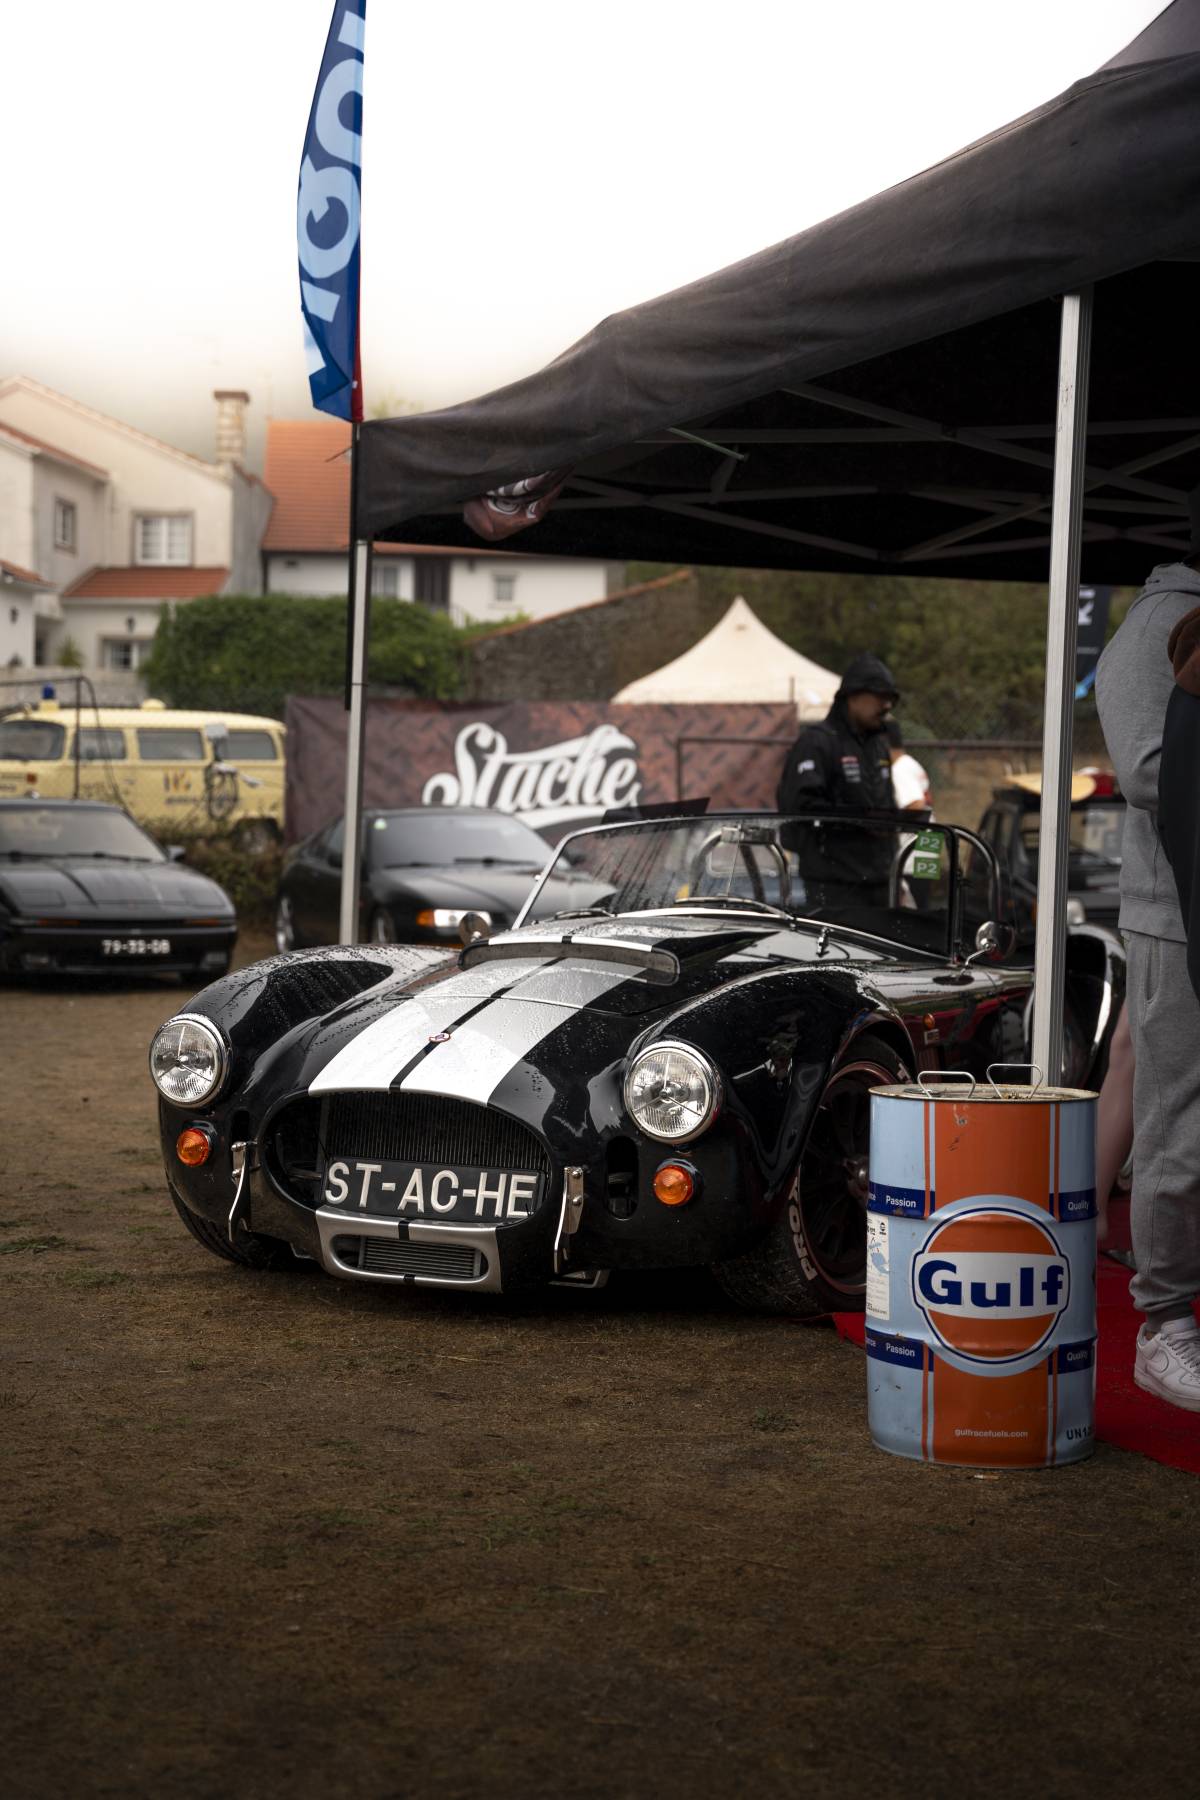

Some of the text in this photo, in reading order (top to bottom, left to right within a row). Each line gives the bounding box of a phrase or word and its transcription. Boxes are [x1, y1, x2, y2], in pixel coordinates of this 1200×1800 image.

[422, 722, 642, 814] Stache
[919, 835, 941, 849] P2
[916, 860, 938, 874] P2
[324, 1161, 538, 1218] ST-AC-HE
[885, 1194, 917, 1209] Passion
[1067, 1199, 1090, 1212] Quality
[918, 1259, 1065, 1308] Gulf
[885, 1342, 916, 1358] Passion
